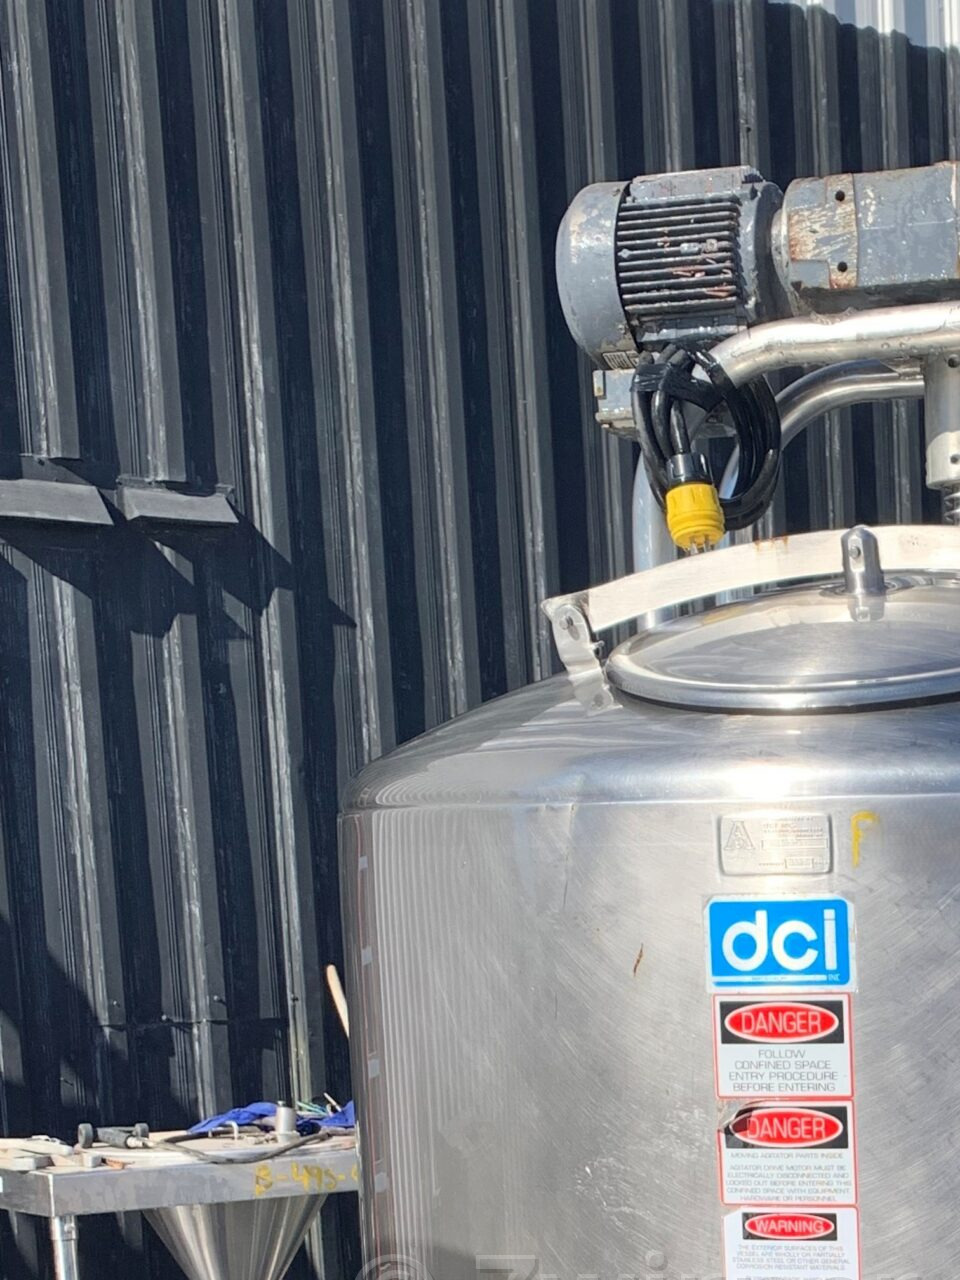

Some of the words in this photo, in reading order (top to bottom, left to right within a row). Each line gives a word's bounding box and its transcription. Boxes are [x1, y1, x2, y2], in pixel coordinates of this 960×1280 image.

[722, 909, 838, 971] dci
[741, 1011, 822, 1035] DANGER
[759, 1048, 806, 1060] FOLLOW
[734, 1060, 791, 1070] CONFINED
[794, 1060, 832, 1070] SPACE
[729, 1072, 766, 1081] ENTRY
[769, 1071, 838, 1081] PROCEDURE
[733, 1082, 776, 1092] BEFORE
[778, 1082, 836, 1092] ENTERING
[746, 1117, 826, 1139] DANGER
[754, 1220, 825, 1234] WARNING
